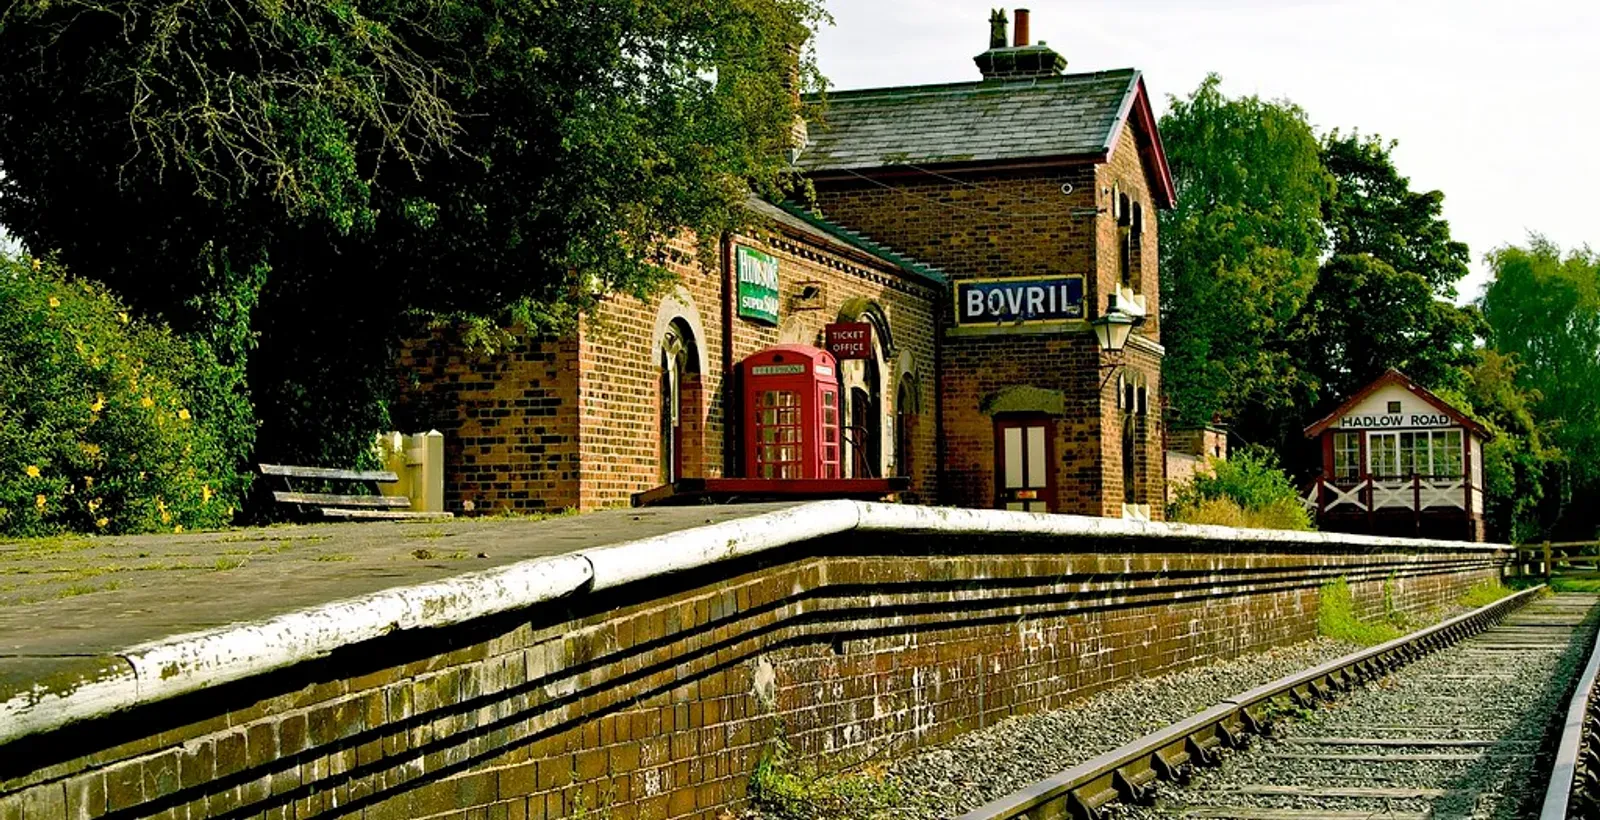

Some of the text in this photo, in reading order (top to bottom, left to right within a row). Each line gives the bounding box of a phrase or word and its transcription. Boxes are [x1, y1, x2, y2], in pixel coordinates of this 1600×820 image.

[967, 285, 1079, 317] BOVRIL
[833, 331, 864, 340] TICKET
[833, 343, 864, 352] OFFICE
[1341, 415, 1449, 427] HADLOW ROAD
